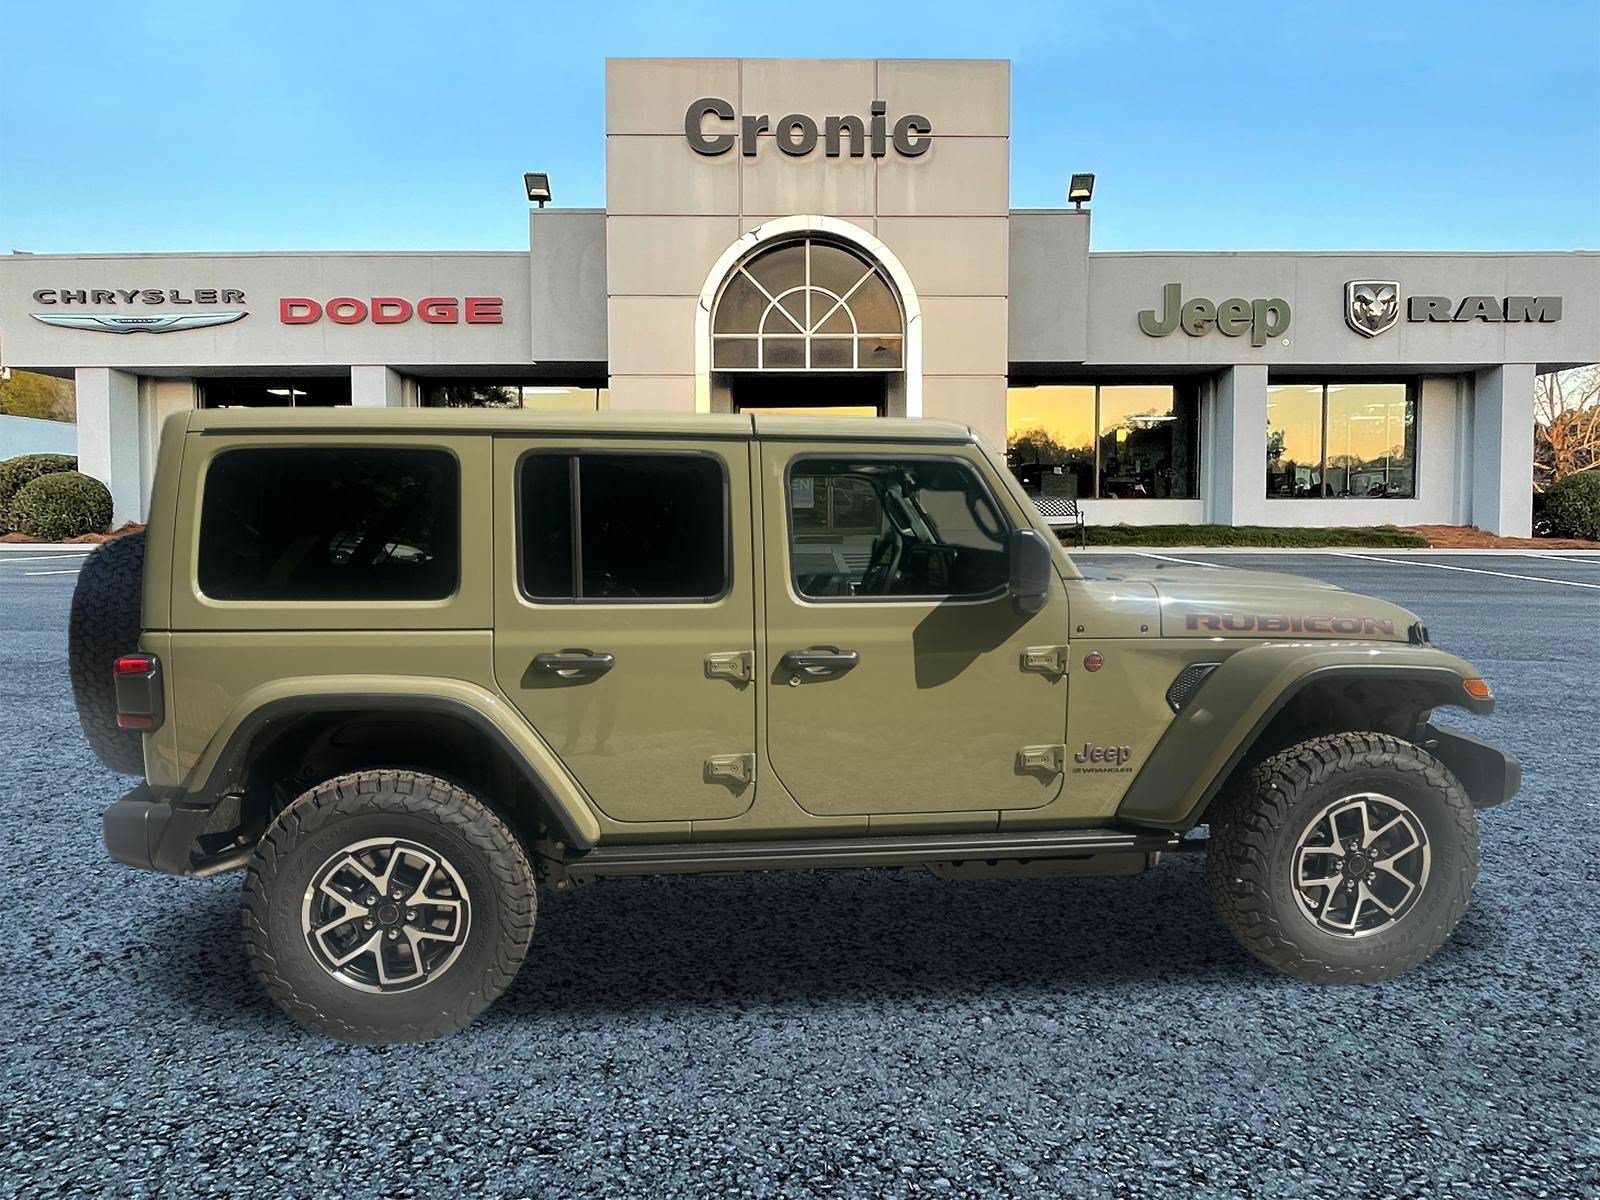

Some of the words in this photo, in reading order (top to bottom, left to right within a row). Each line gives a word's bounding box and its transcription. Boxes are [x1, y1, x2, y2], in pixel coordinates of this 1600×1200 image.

[685, 97, 932, 157] Cronic
[32, 288, 248, 305] CHRYSLER
[1407, 296, 1563, 323] RAM
[280, 296, 504, 325] DODGE
[1138, 283, 1291, 347] Jeep
[1184, 613, 1395, 635] RUBICON
[1075, 742, 1132, 766] Jeep
